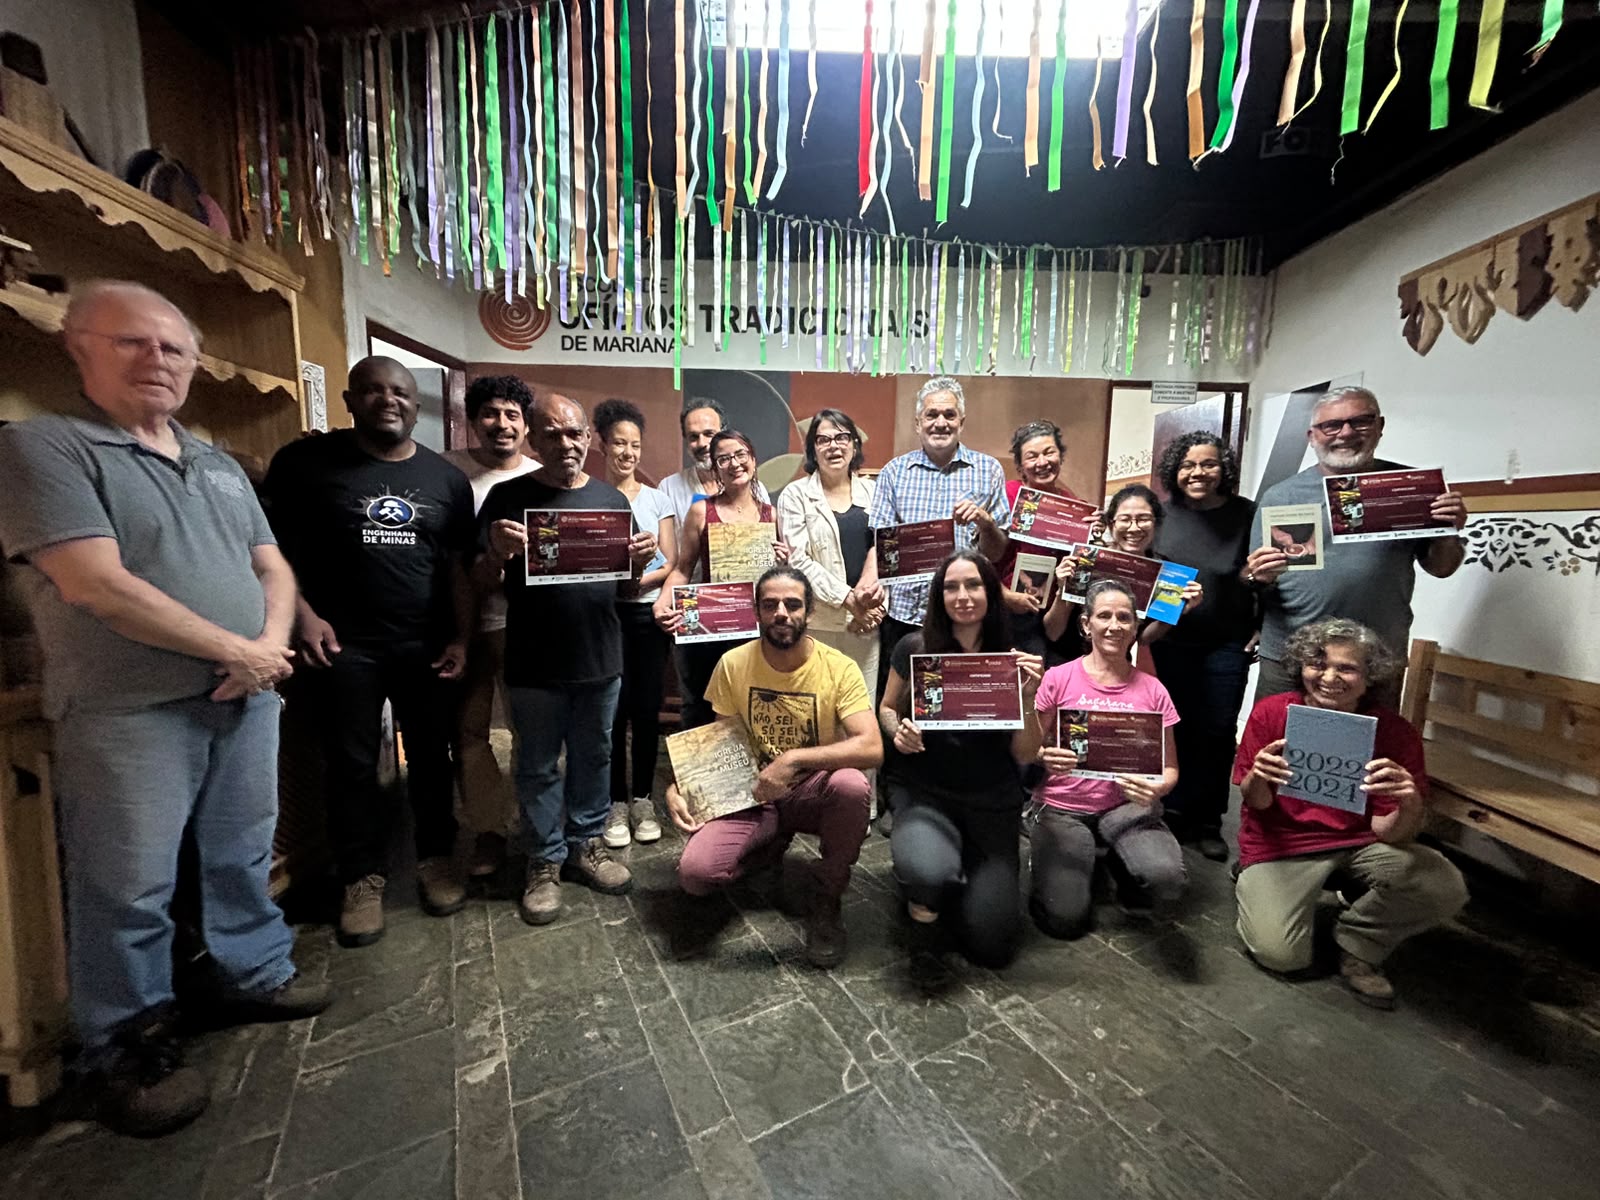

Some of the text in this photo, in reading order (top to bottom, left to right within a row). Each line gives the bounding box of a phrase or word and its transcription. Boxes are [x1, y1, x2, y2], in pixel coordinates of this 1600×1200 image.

[557, 276, 668, 294] SCOL DE
[558, 293, 930, 339] OFÍCOS TRADICIONAS
[561, 335, 675, 353] DE MARIANA
[362, 529, 417, 538] ENGENHARIA
[363, 536, 416, 545] DE MINAS
[753, 712, 793, 726] NÃO SEI
[762, 724, 798, 736] SÓ SEI
[758, 735, 796, 746] QUE FOI
[713, 743, 745, 759] IGREJA
[724, 751, 748, 763] CASA
[719, 759, 750, 773] MUSEU
[1289, 748, 1363, 781] 2022
[1287, 773, 1357, 803] 2024
